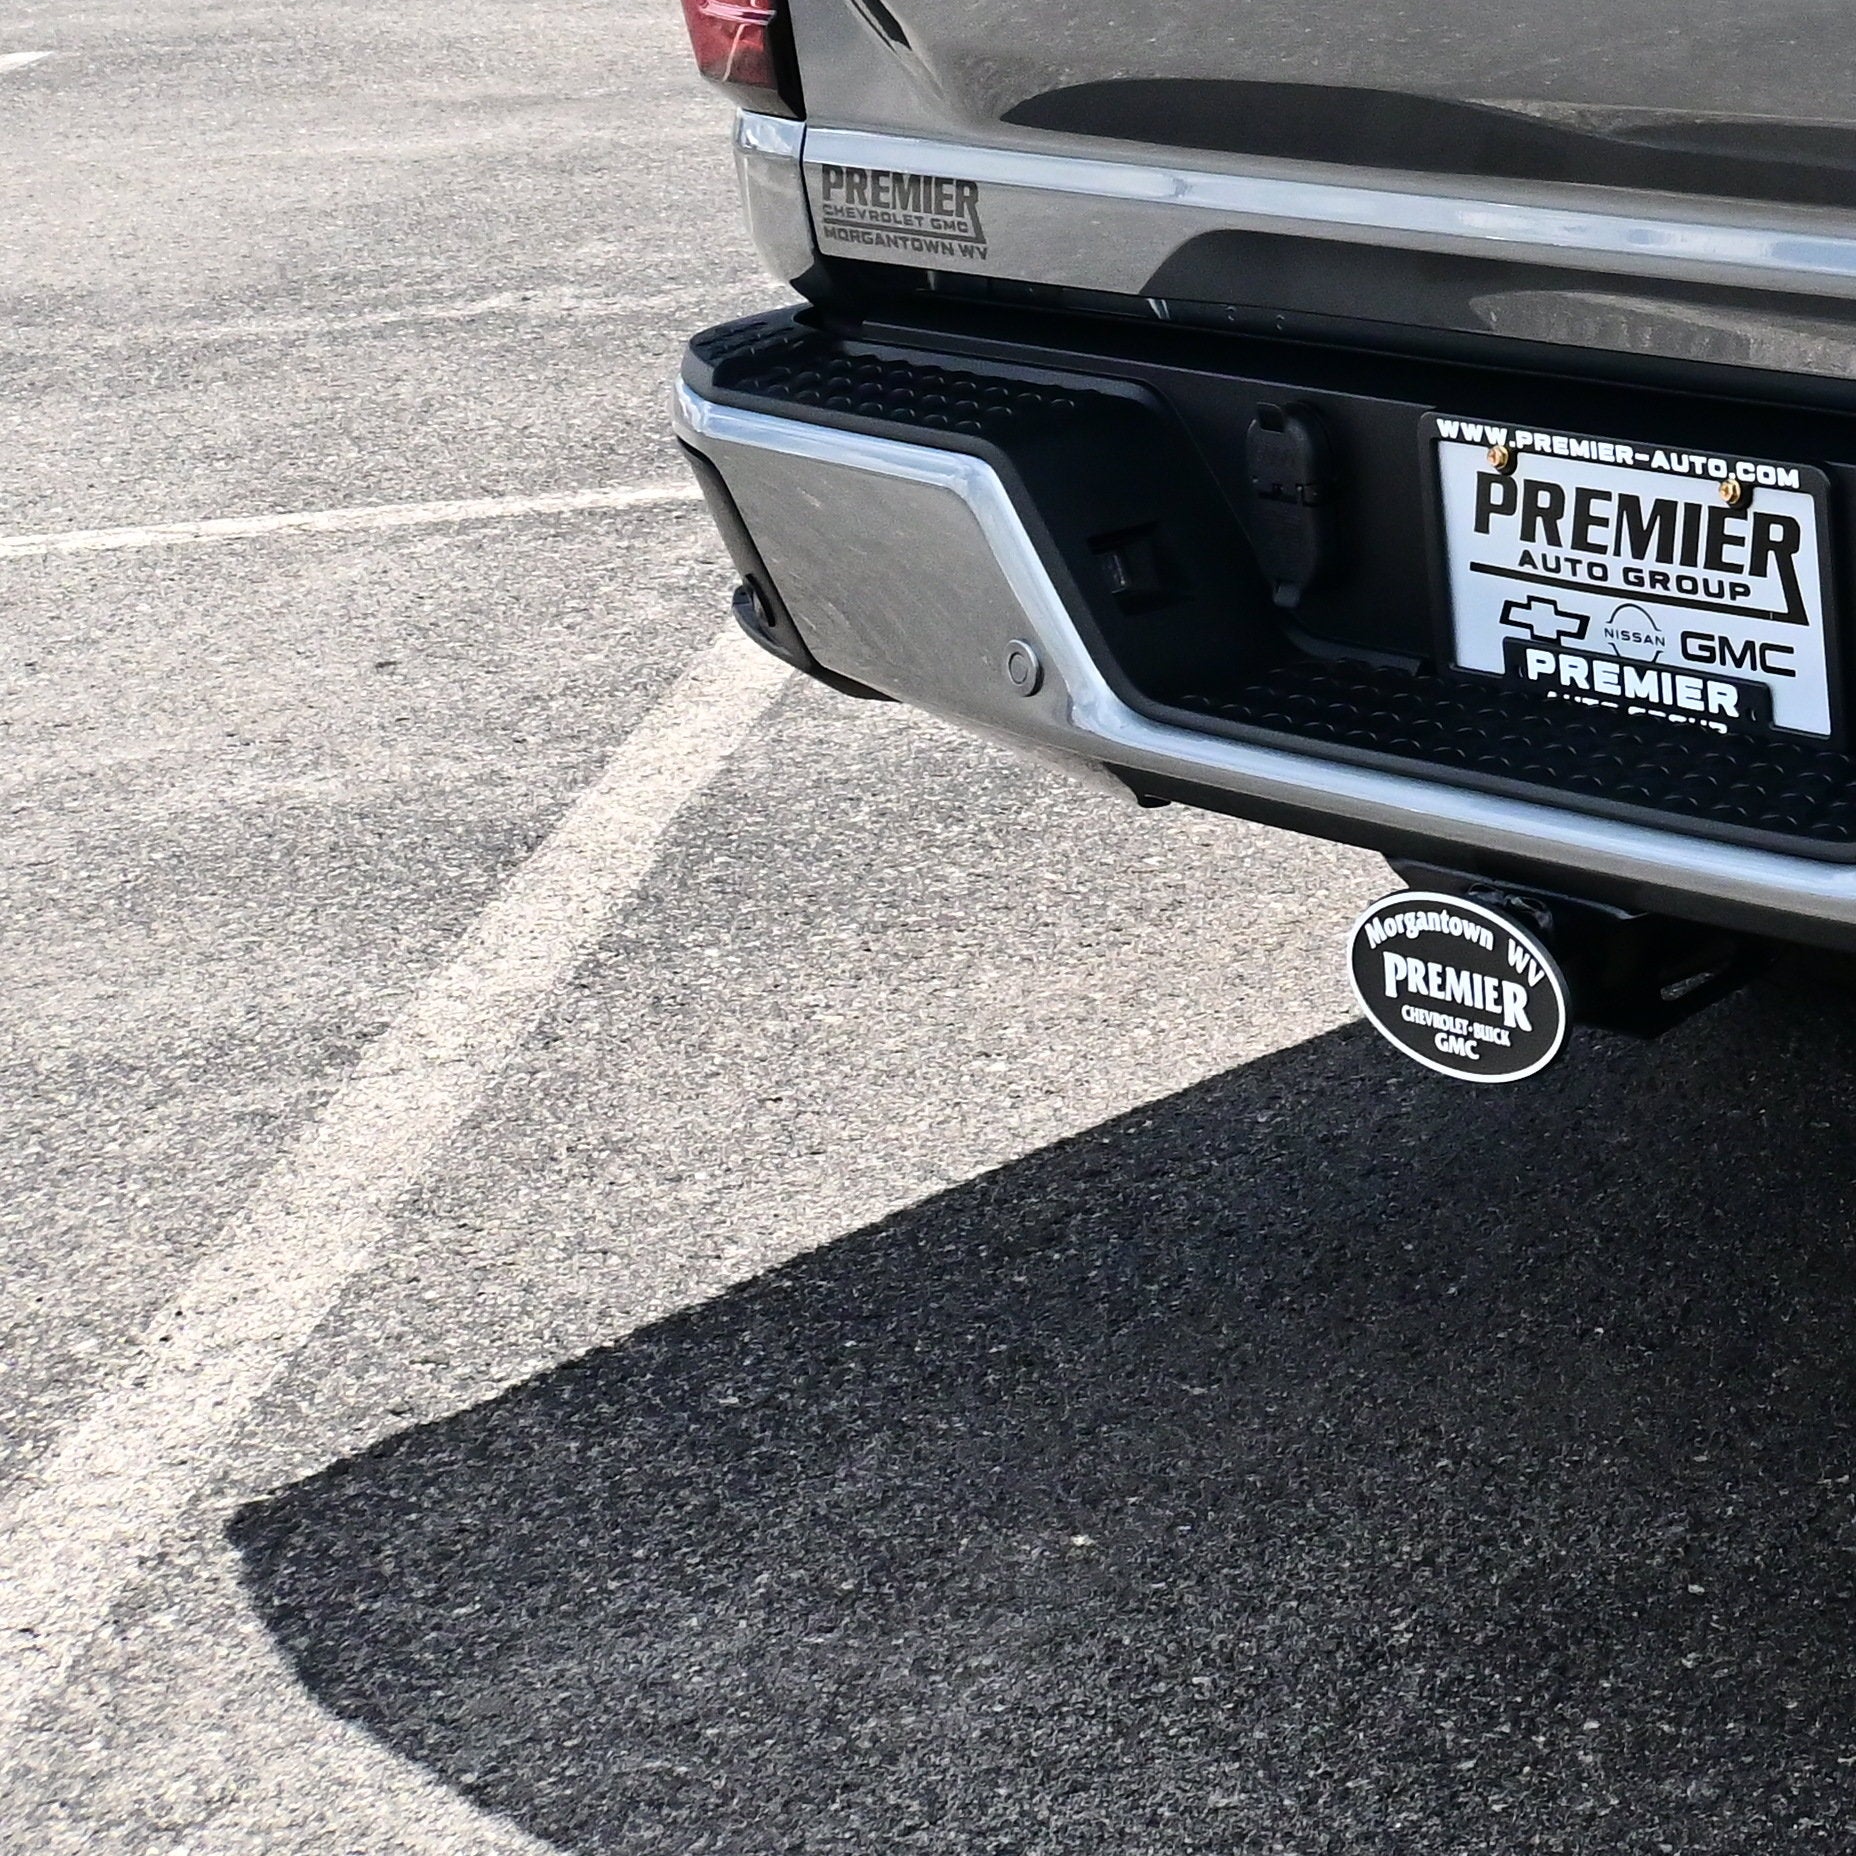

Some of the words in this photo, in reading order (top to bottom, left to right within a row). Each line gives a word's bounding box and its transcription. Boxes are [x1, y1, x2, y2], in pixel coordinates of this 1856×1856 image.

[822, 163, 982, 222] PREMIER
[822, 203, 924, 228] CHEVROLET
[930, 218, 969, 234] GMC
[823, 226, 955, 257] MORGANTOWN
[956, 244, 988, 260] WV
[1436, 418, 1799, 489] WWW.PREMIER-AUTO.COM
[1474, 471, 1803, 586] PREMIER
[1518, 550, 1609, 583] AUTO
[1622, 566, 1751, 601] GROUP
[1604, 627, 1666, 647] NISSAN
[1680, 630, 1796, 677] GMC
[1525, 647, 1740, 718] PREMIER
[1364, 909, 1494, 950] Morgantown
[1507, 938, 1546, 987] WV
[1382, 951, 1533, 1032] PREMIER
[1434, 1032, 1480, 1060] GMC
